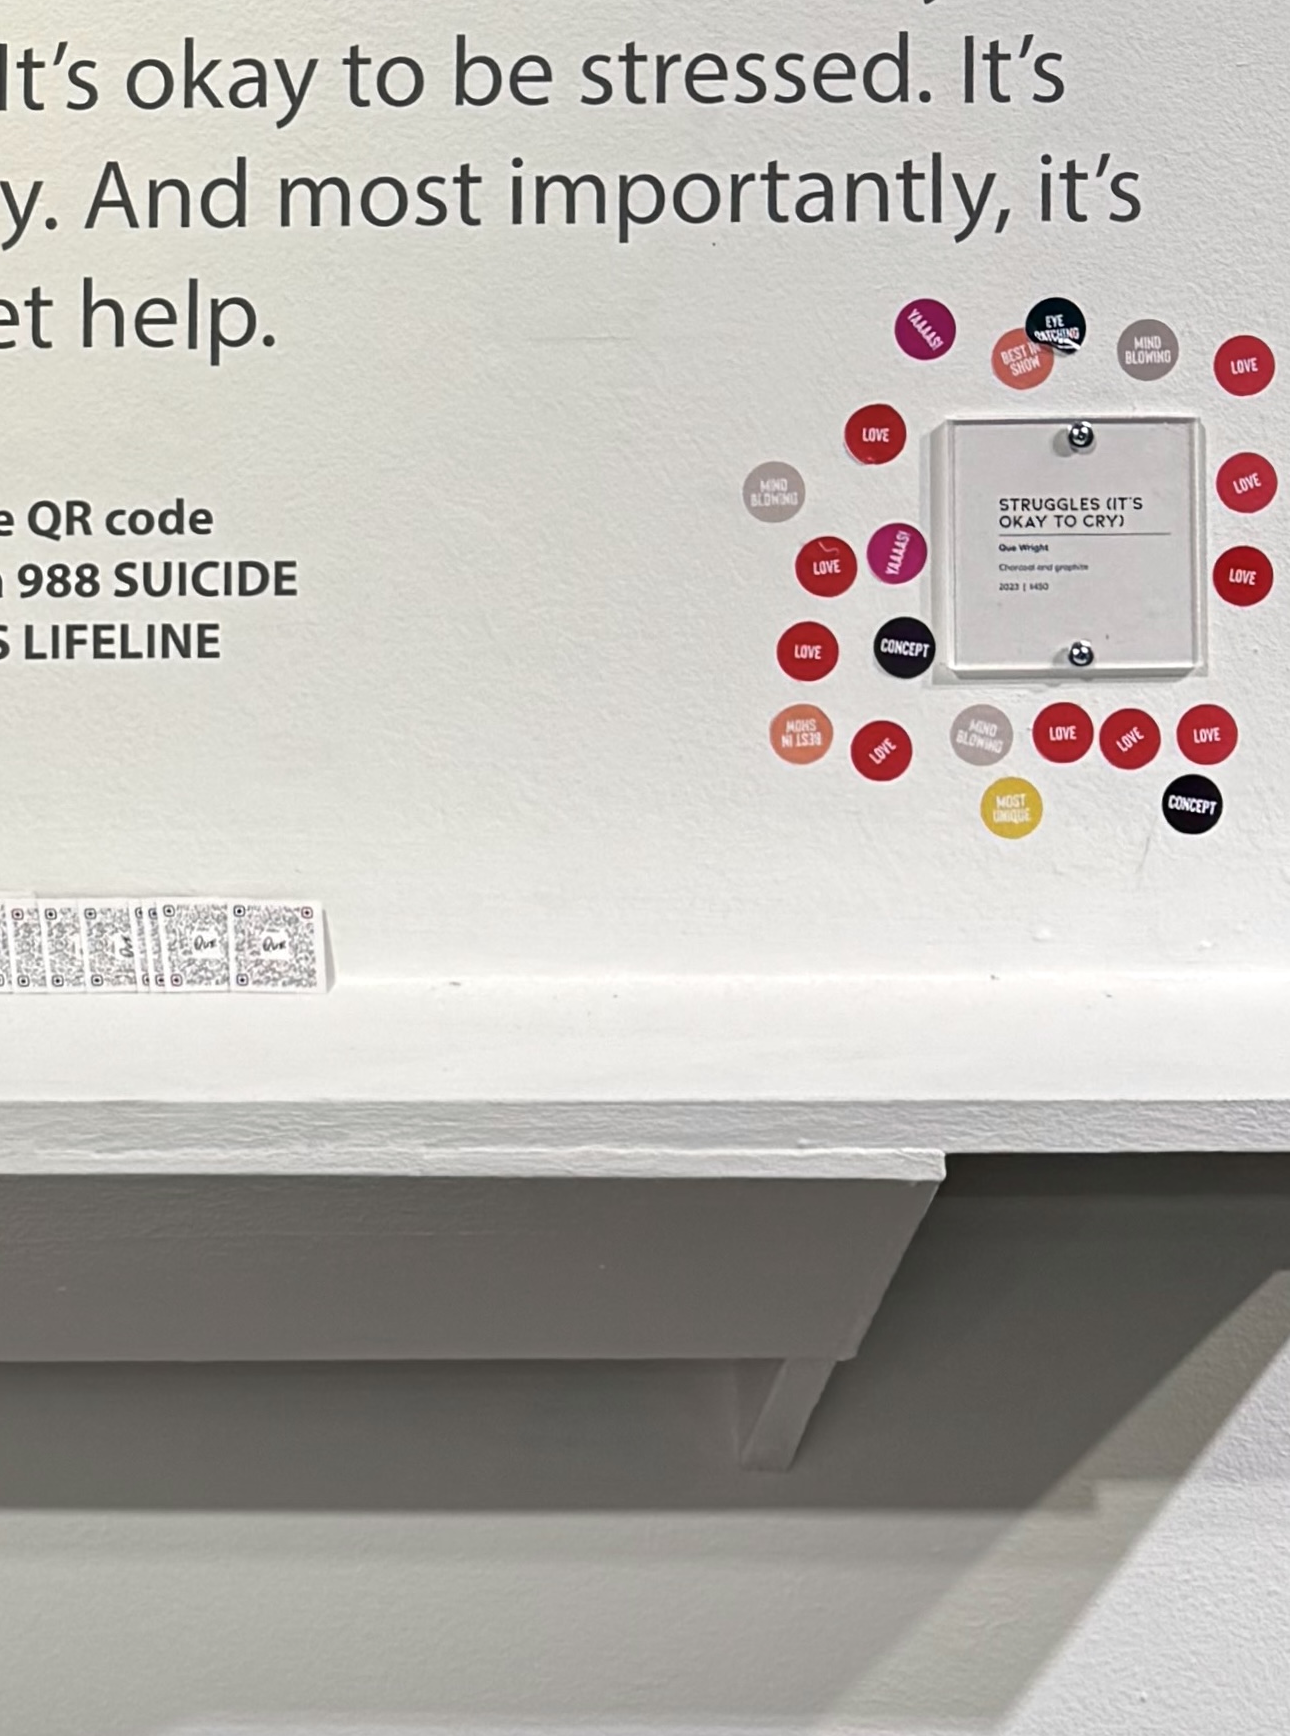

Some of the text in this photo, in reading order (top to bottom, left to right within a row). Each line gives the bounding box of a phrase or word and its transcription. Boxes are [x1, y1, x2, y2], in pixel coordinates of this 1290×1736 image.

[124, 35, 321, 131] okay
[340, 42, 426, 109] to
[453, 32, 554, 108] be
[578, 29, 933, 107] stressed.
[962, 32, 1066, 105] It’s
[82, 154, 248, 231] And
[278, 161, 484, 229] most
[510, 150, 1012, 245] importantly,
[1039, 151, 1143, 224] it’s
[81, 275, 277, 368] help.
[1045, 314, 1065, 329] EYE
[1134, 335, 1162, 349] MIND
[1000, 343, 1028, 365] BEST
[1124, 349, 1171, 365] BLOWING
[1009, 354, 1041, 377] SHOW
[1230, 357, 1258, 375] LOVE
[862, 427, 890, 443] LOVE
[760, 478, 789, 492] MIND
[1233, 472, 1262, 495] LOVE
[750, 491, 799, 507] BLOWING
[998, 496, 1101, 512] STRUGGLES
[26, 498, 95, 543] QR
[103, 496, 215, 538] code
[998, 514, 1125, 529] OKAY TO CRY)
[998, 543, 1050, 554] Que Wright
[812, 559, 841, 576] LOVE
[998, 563, 1089, 574] Charcoal and graphite
[16, 561, 102, 601] 988
[112, 558, 299, 600] SUICIDE
[1228, 568, 1257, 586] LOVE
[998, 582, 1020, 591] 2023
[23, 621, 222, 662] LIFELINE
[880, 637, 930, 658] CONCEPT
[794, 644, 822, 660] LOVE
[786, 718, 817, 733] SHOW
[969, 719, 998, 736] MIND
[1049, 725, 1077, 741] LOVE
[781, 731, 822, 748] BEST IN
[955, 729, 1004, 754] BLOWING
[1116, 726, 1145, 752] LOVE
[1193, 727, 1221, 744] LOVE
[868, 737, 897, 765] LOVE
[996, 793, 1026, 808] MOST
[1167, 794, 1218, 816] CONCEPT
[993, 808, 1031, 824] UNIQUE
